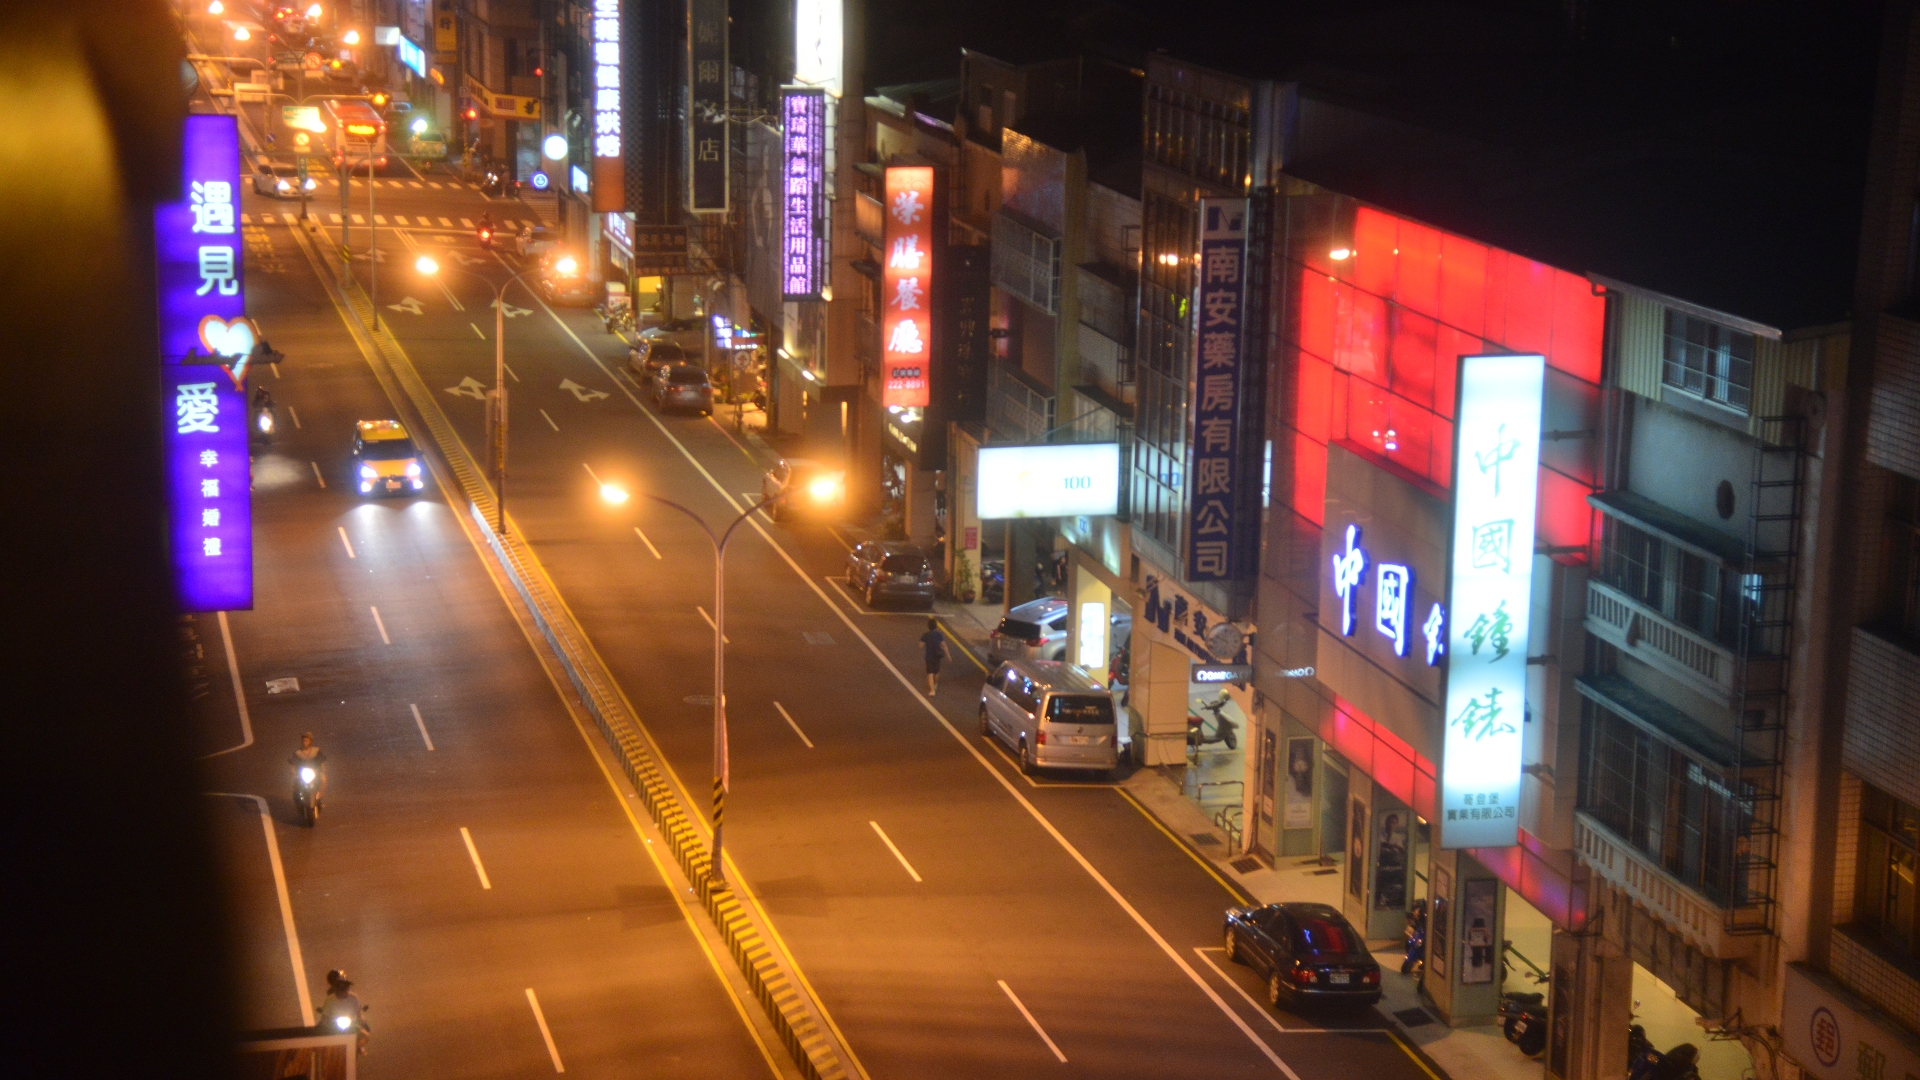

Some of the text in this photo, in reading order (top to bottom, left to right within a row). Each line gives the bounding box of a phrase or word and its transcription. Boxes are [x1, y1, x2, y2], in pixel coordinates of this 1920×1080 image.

[790, 96, 808, 294] 寶琦華舞蹈生活用品館
[888, 190, 924, 354] 榮膳餐廳
[1196, 246, 1240, 578] 南安藥房有限公司
[1447, 806, 1515, 821] 實業有限公司
